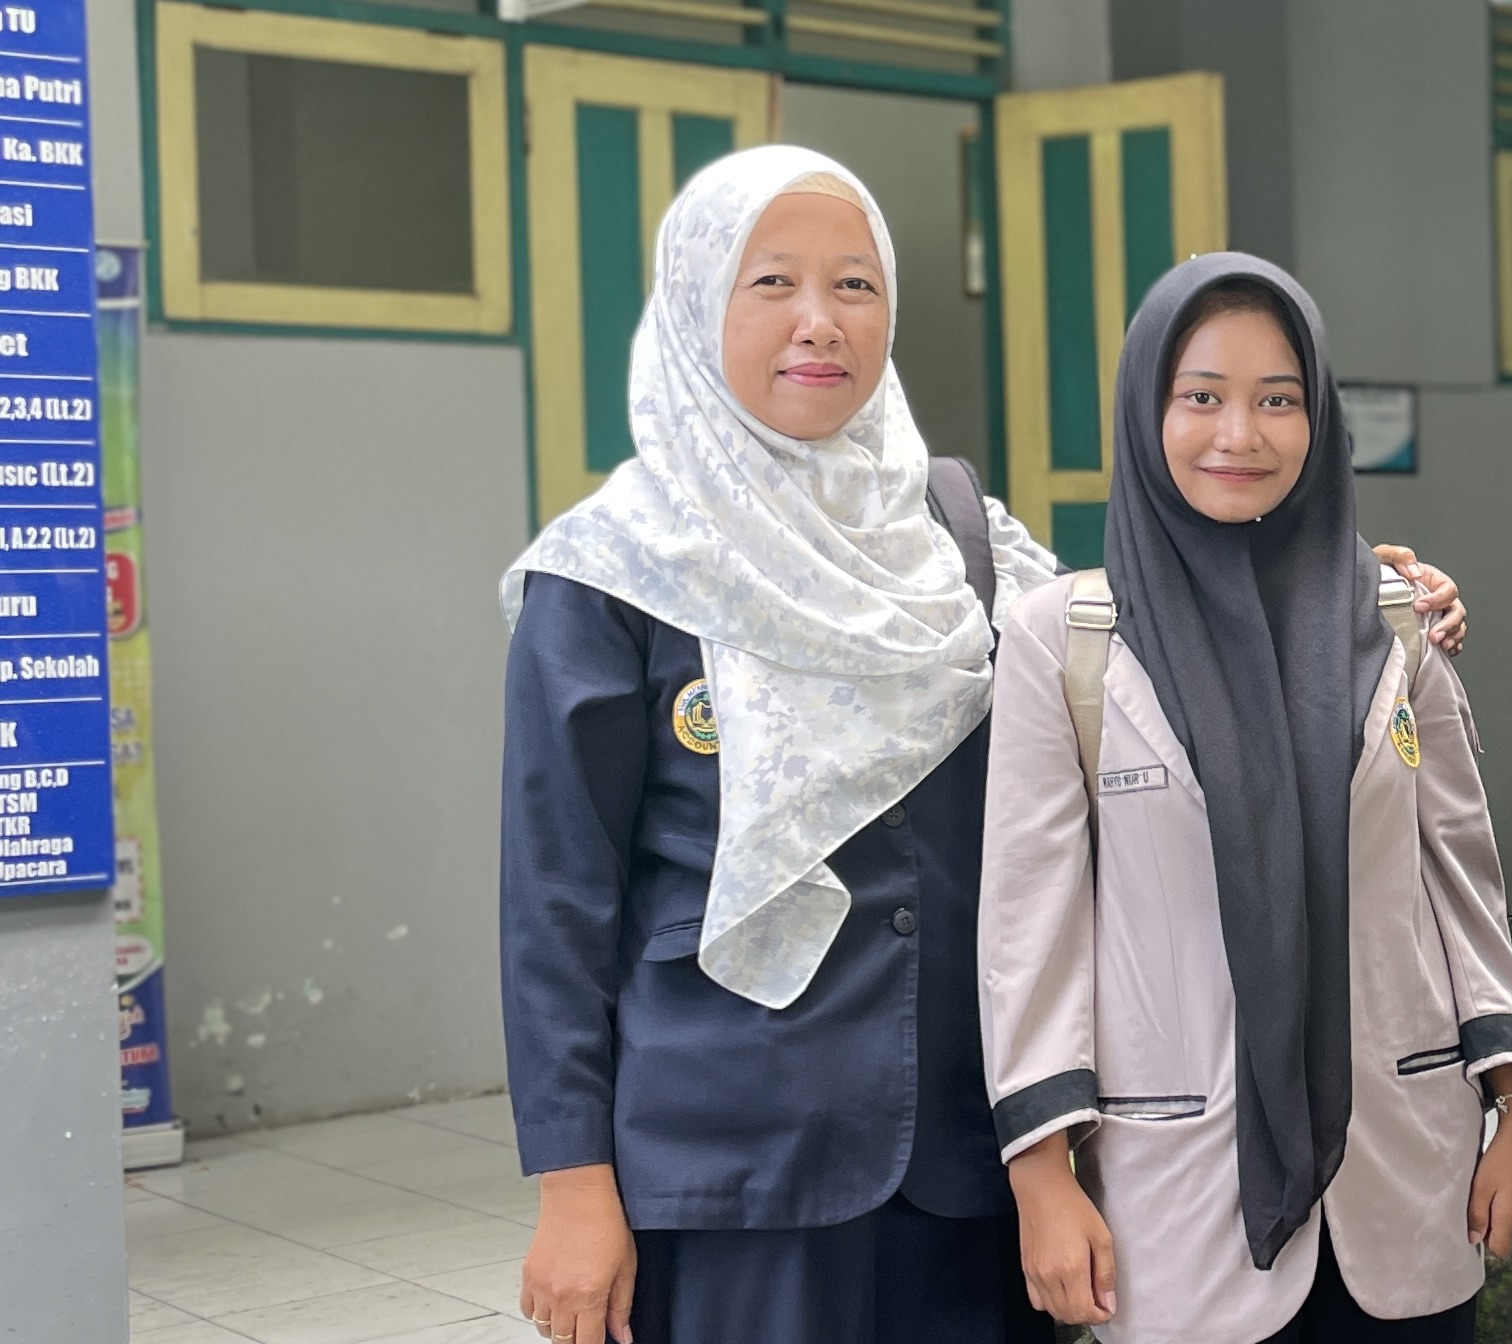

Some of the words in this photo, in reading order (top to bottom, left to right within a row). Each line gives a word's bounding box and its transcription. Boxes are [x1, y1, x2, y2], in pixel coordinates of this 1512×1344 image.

[6, 7, 36, 34] TU
[24, 75, 82, 105] Putri
[3, 138, 37, 162] Ka.
[39, 140, 83, 166] BKK
[0, 204, 33, 226] asi
[14, 267, 59, 291] BKK
[0, 333, 28, 357] et
[41, 462, 94, 487] (Lt.2)
[11, 527, 51, 549] A.2.2
[54, 527, 96, 549] (Lt.2)
[0, 596, 37, 616] uru
[20, 655, 100, 679] Sekolah
